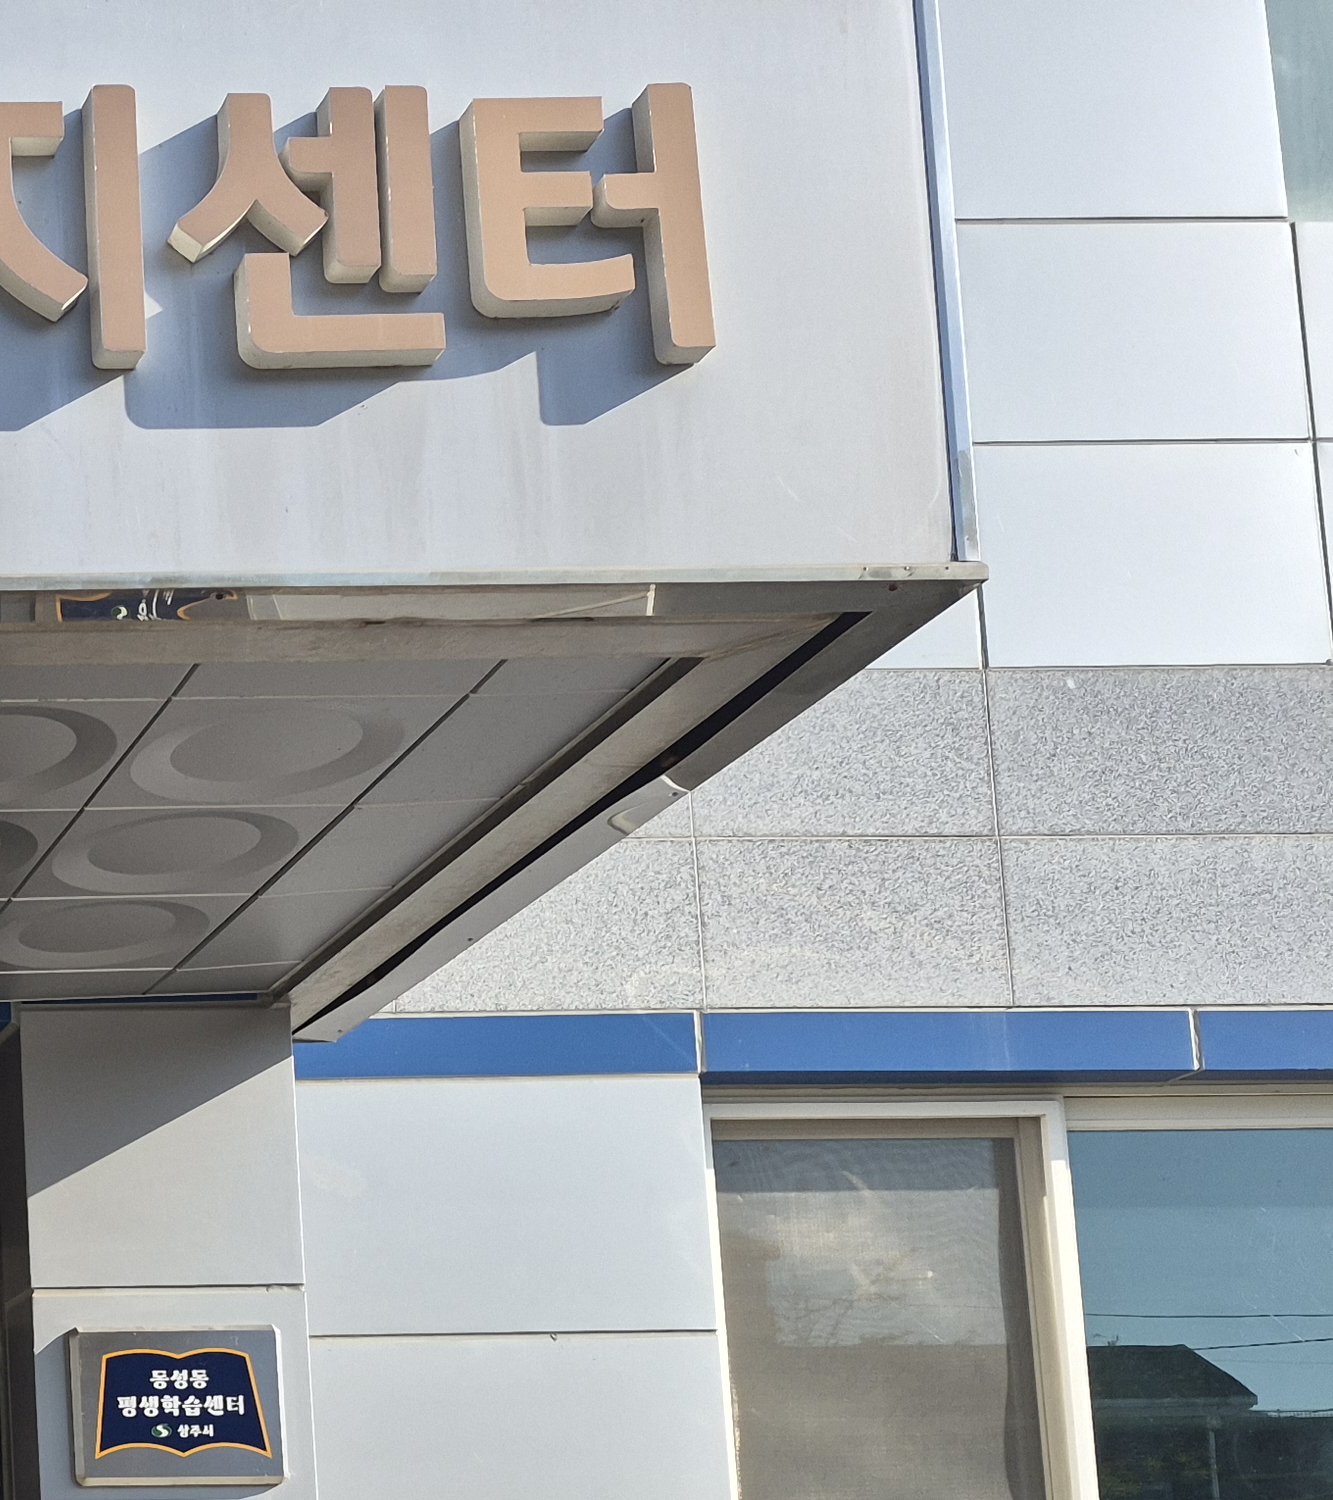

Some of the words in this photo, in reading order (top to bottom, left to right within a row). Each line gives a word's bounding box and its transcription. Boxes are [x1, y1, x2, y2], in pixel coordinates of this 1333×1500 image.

[149, 1369, 210, 1390] 동성동
[116, 1394, 245, 1418] 평생학습센터
[177, 1424, 214, 1438] 상주시
